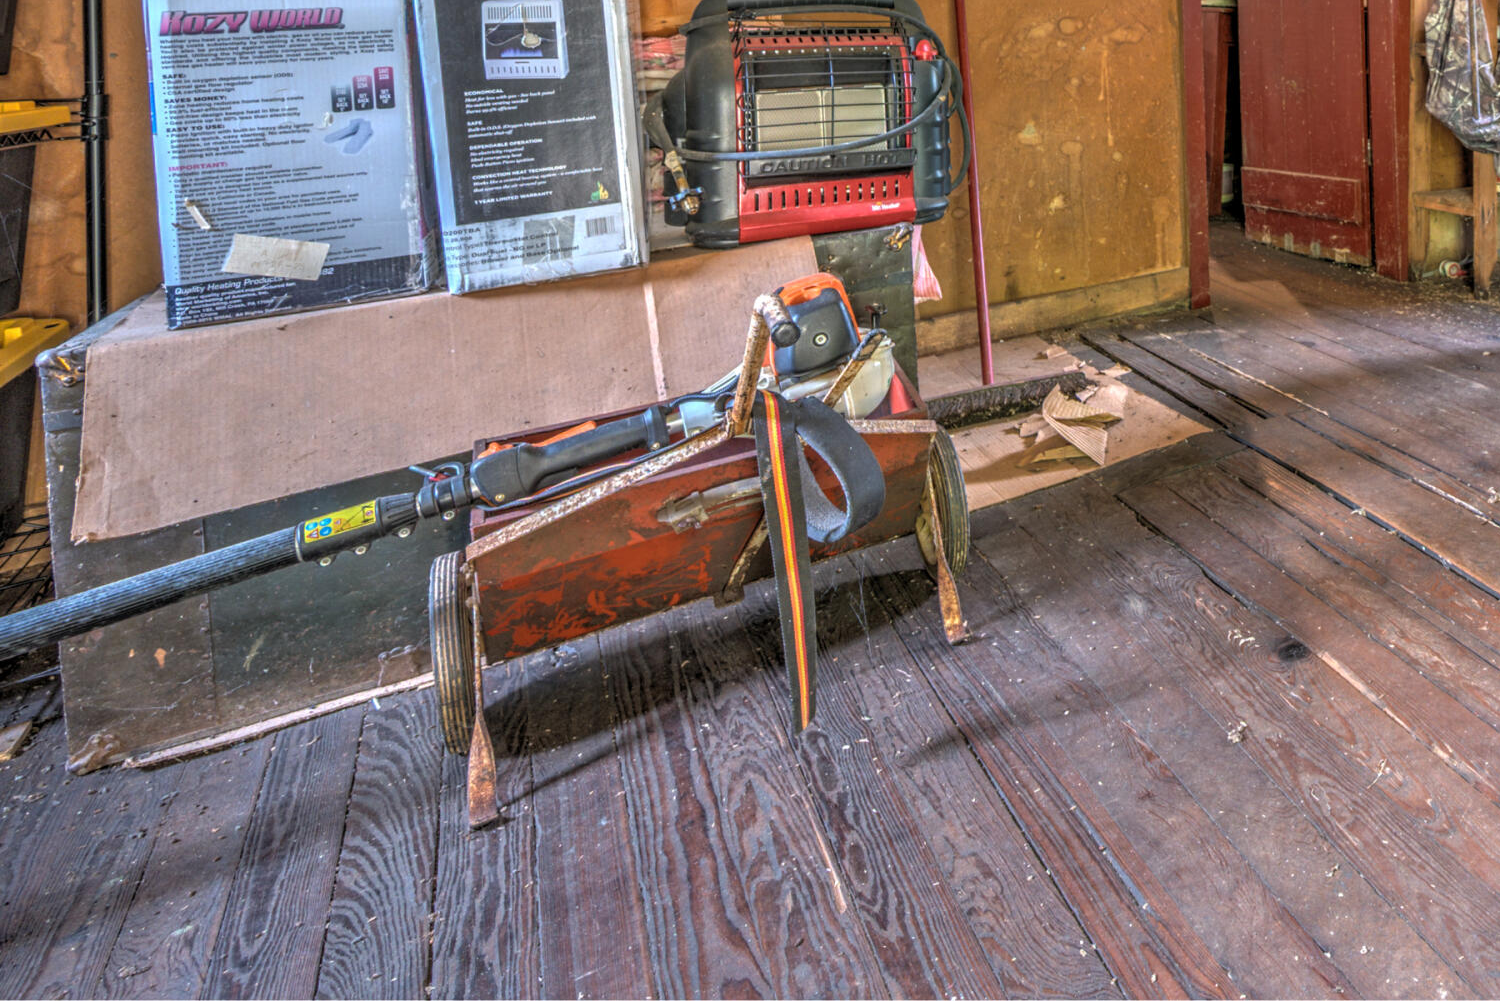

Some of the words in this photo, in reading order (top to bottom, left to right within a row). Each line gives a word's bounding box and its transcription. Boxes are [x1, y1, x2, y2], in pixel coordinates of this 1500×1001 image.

[464, 88, 503, 96] ECONOMICAL
[469, 141, 507, 150] DEPENDABLE
[509, 138, 542, 146] OPERATION
[168, 161, 227, 171] IMPORTANT:
[759, 155, 847, 174] CAUTION
[863, 153, 899, 166] HOT
[472, 171, 510, 180] CONVECTION
[528, 164, 566, 173] TECHNOLOGY
[520, 190, 552, 199] WARRANTY
[484, 235, 528, 246] Thermostat
[529, 231, 558, 240] Control
[471, 250, 489, 258] Dual
[490, 247, 507, 255] Fuel
[547, 244, 578, 254] Optional
[174, 284, 204, 296] Quality
[207, 280, 241, 291] Heating
[244, 273, 282, 285] Products
